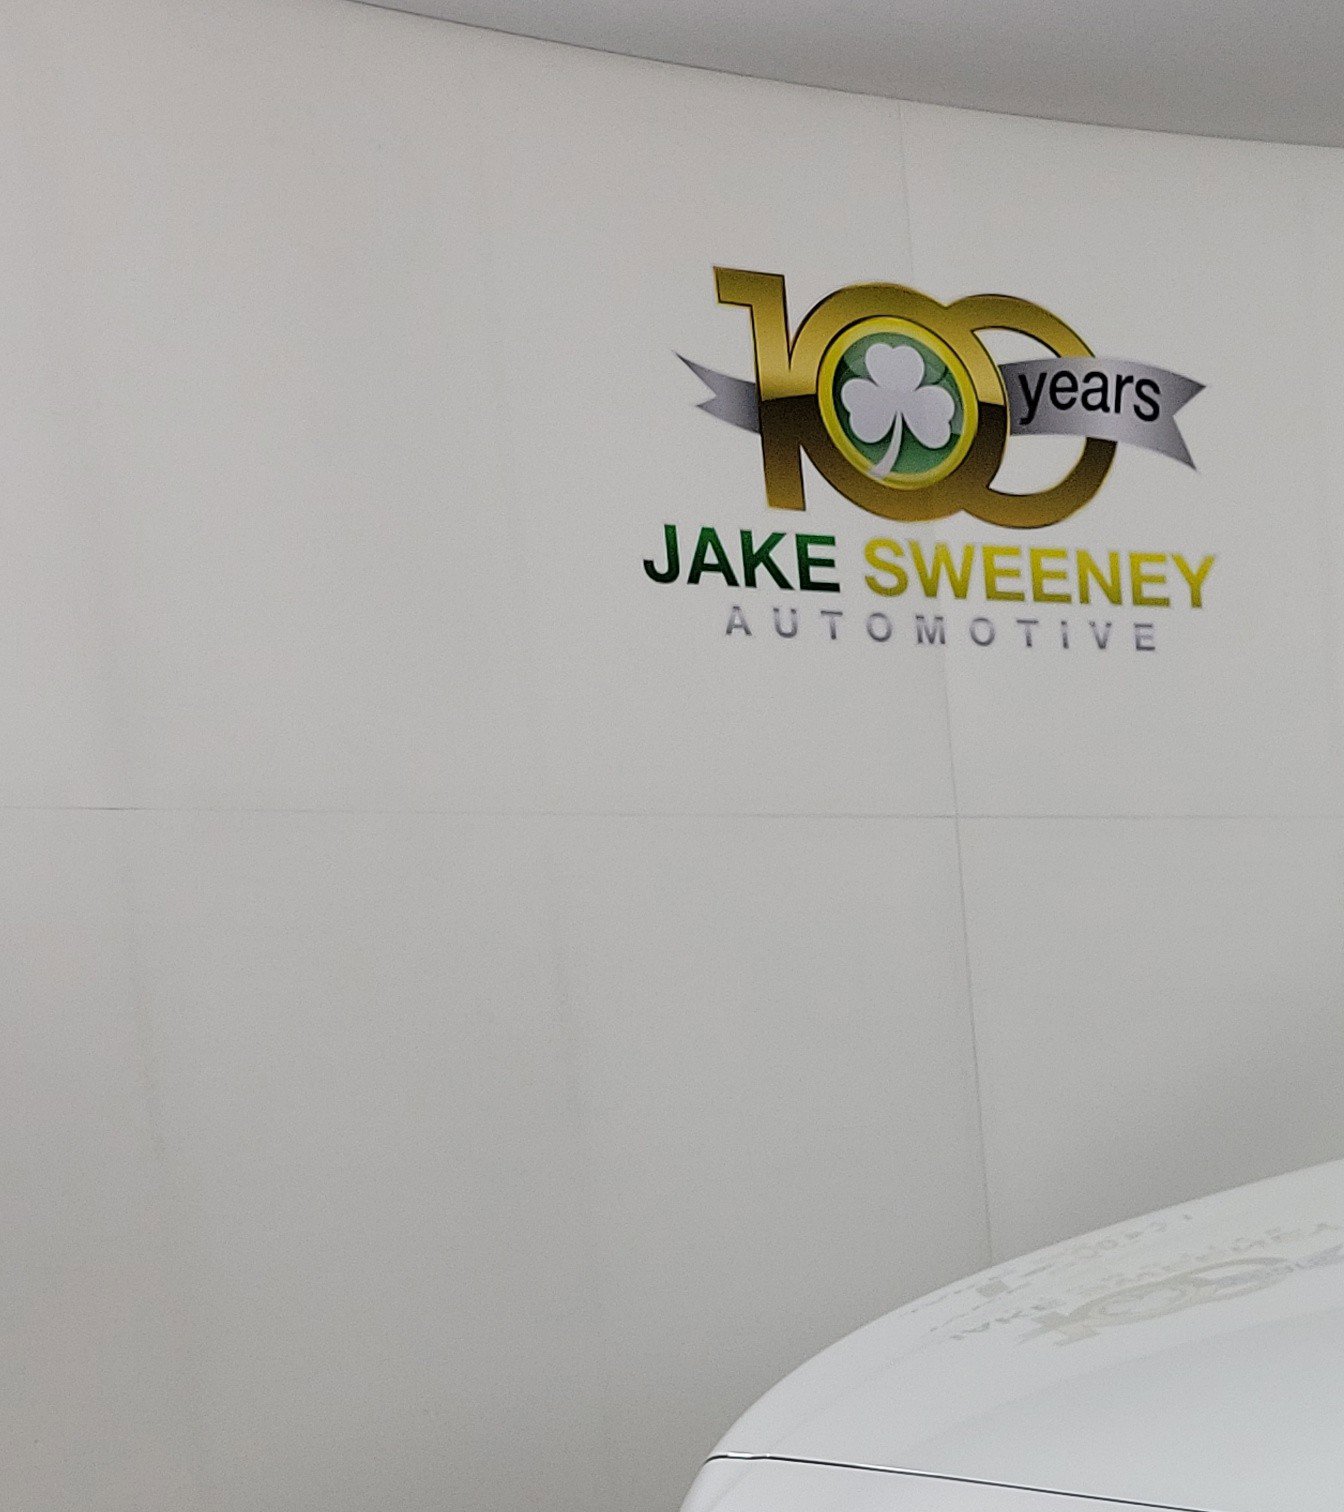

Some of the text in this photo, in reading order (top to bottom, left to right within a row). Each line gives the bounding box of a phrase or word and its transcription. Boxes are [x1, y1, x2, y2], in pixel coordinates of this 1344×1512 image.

[712, 266, 1162, 529] 100 years
[642, 524, 1217, 611] JAKE SWEENEY
[725, 604, 1158, 653] AUTOMOTIVE
